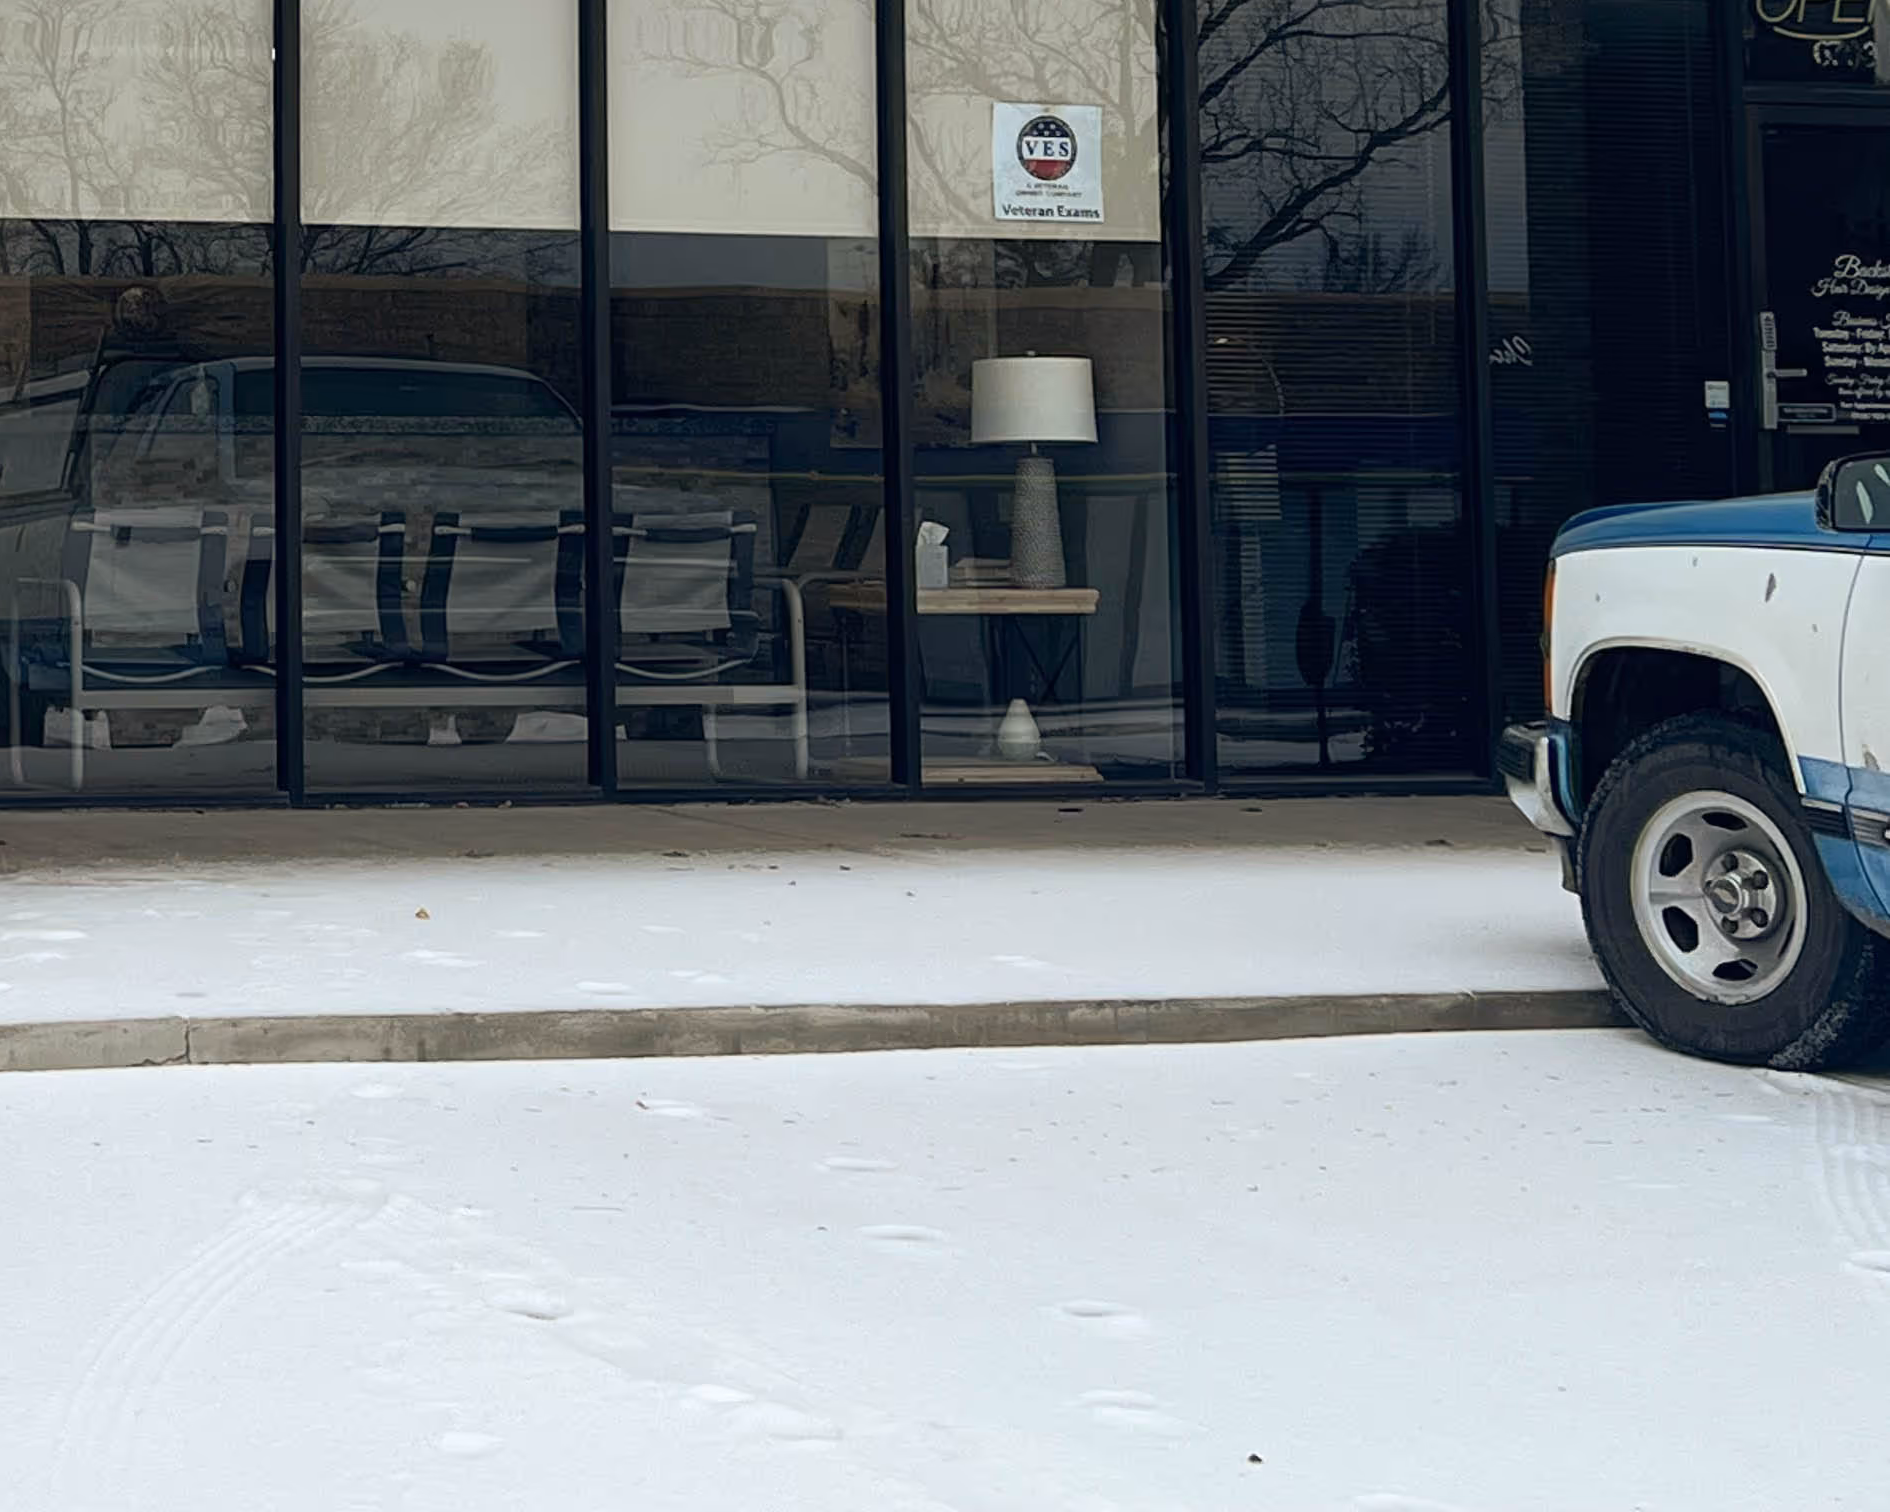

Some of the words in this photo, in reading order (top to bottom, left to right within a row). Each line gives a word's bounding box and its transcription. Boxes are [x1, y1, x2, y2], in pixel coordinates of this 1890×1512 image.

[1024, 140, 1070, 158] VES
[1002, 204, 1054, 217] Veteran
[1057, 205, 1100, 219] Exams
